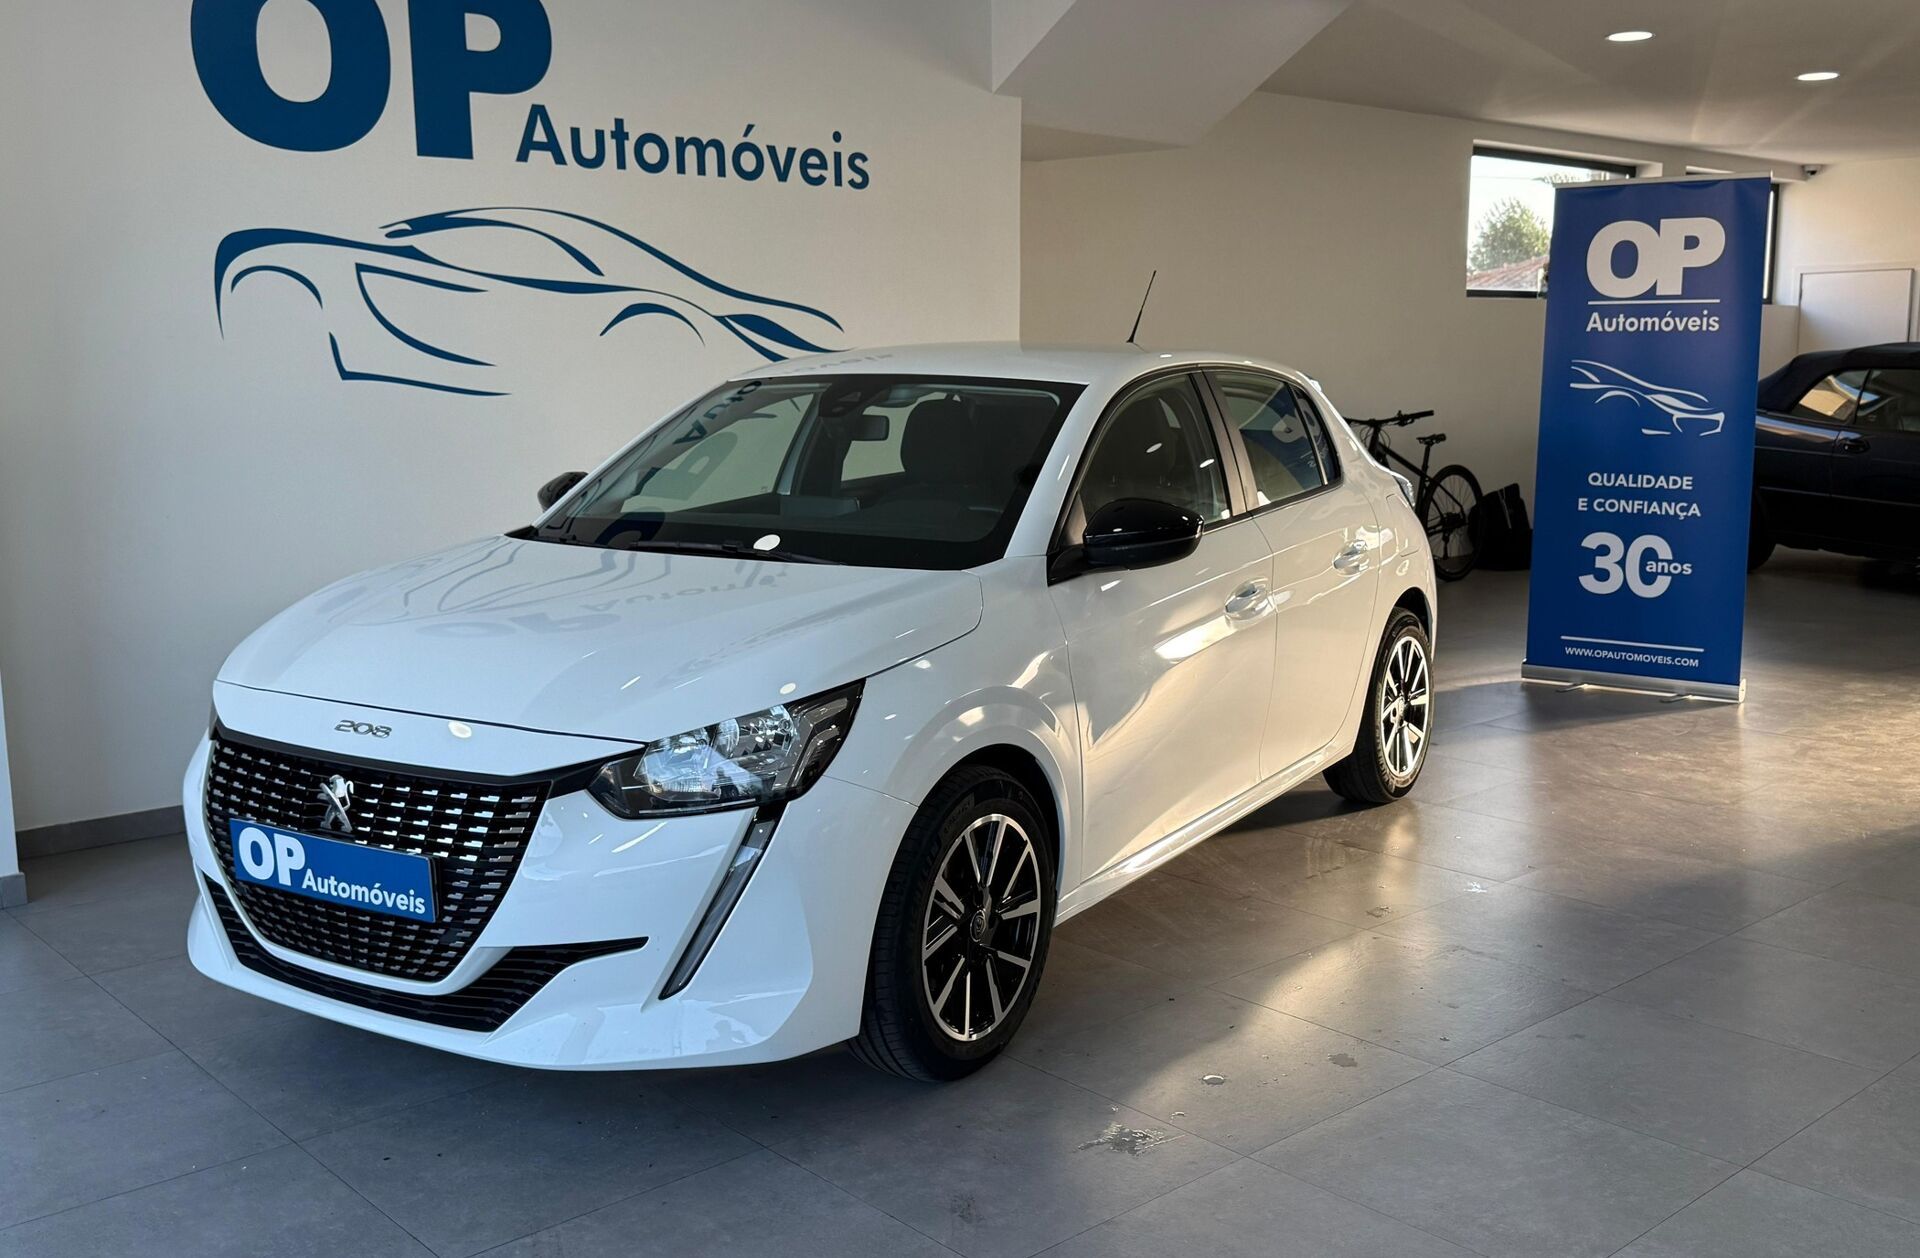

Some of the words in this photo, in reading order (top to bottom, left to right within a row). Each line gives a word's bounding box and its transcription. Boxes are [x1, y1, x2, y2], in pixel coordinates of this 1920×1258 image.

[190, 0, 552, 160] OP
[515, 103, 870, 190] Automóveis
[1586, 216, 1726, 299] OP
[1585, 309, 1720, 333] Automóveis
[1587, 472, 1694, 490] QUALIDADE
[1577, 498, 1588, 511] E
[1593, 498, 1701, 520] CONFIANÇA
[1578, 531, 1674, 599] 30
[1645, 560, 1693, 575] anos
[1564, 646, 1699, 668] WWW.OPAUTOMOVEIS.COM
[334, 719, 392, 738] 208
[238, 826, 306, 887] OP
[301, 868, 426, 915] Automóveis
